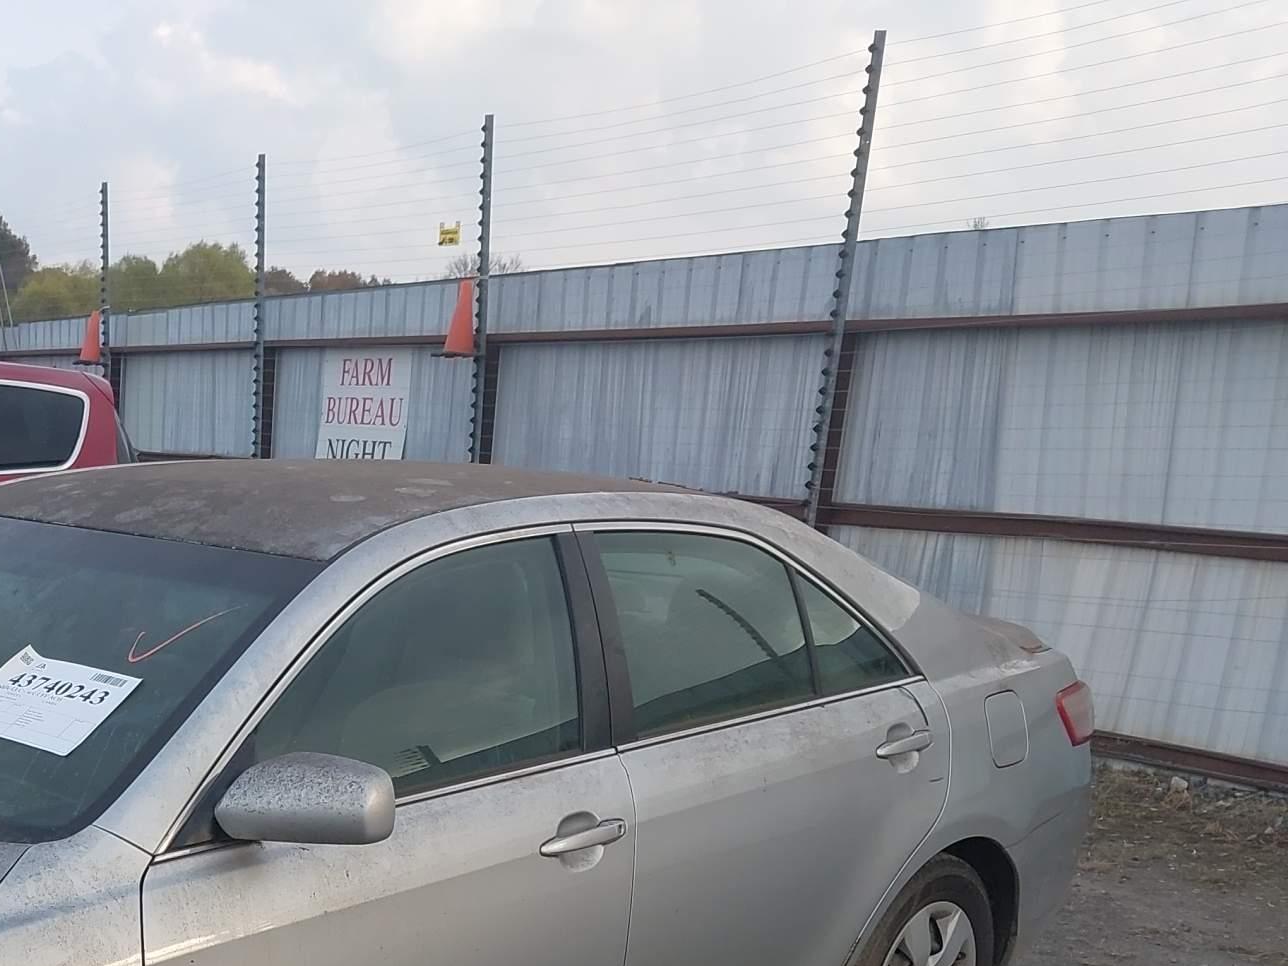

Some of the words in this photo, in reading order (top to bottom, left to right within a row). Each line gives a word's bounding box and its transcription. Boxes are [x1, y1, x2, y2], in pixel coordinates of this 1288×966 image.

[340, 357, 393, 386] FARM
[325, 396, 404, 427] BUREAU
[327, 438, 392, 460] NIGHT
[8, 672, 110, 706] 43740243
